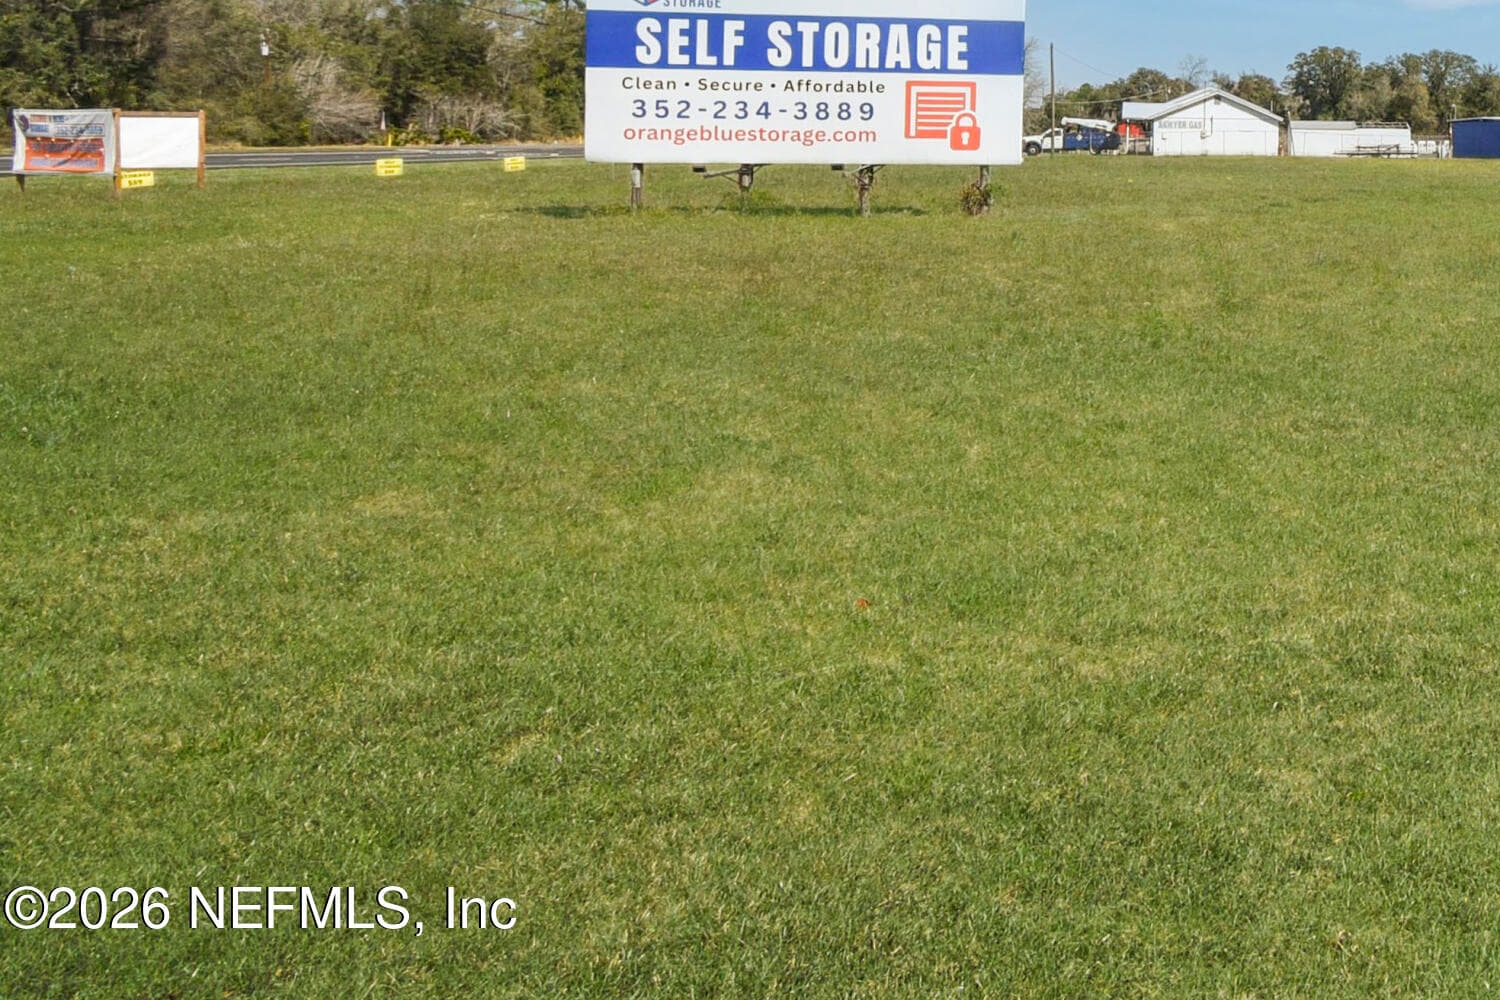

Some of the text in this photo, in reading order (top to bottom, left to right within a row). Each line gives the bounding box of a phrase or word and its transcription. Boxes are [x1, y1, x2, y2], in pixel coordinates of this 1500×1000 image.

[635, 17, 969, 71] SELF STORAGE
[621, 76, 886, 94] Clean Secure Affordable
[631, 99, 875, 121] 352-234-3889
[623, 125, 877, 146] orangebluestorage.com
